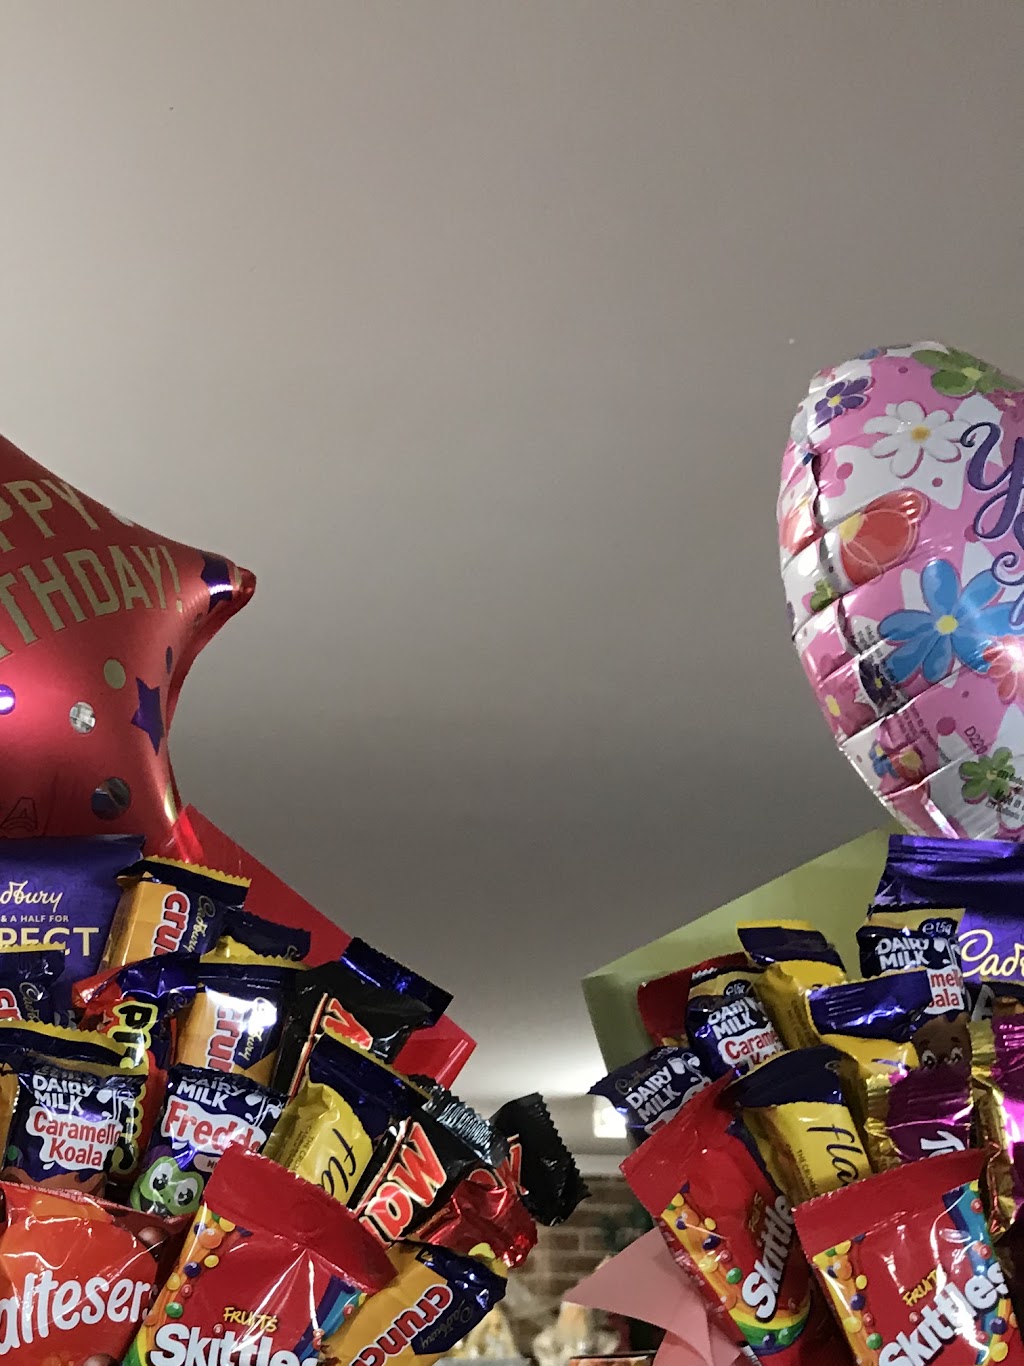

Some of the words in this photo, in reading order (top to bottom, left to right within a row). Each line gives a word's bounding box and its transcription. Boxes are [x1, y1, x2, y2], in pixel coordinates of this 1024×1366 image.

[10, 915, 17, 923] A
[20, 915, 45, 923] HALF
[49, 915, 69, 923] FOR
[879, 950, 930, 971] MILK
[713, 1014, 757, 1040] MILK
[33, 1075, 95, 1098] DAIRY
[176, 1080, 230, 1111] MILK
[625, 1063, 673, 1110] DAIRY
[35, 1091, 84, 1114] MILK
[637, 1085, 682, 1123] MILK
[49, 1137, 103, 1167] Koala
